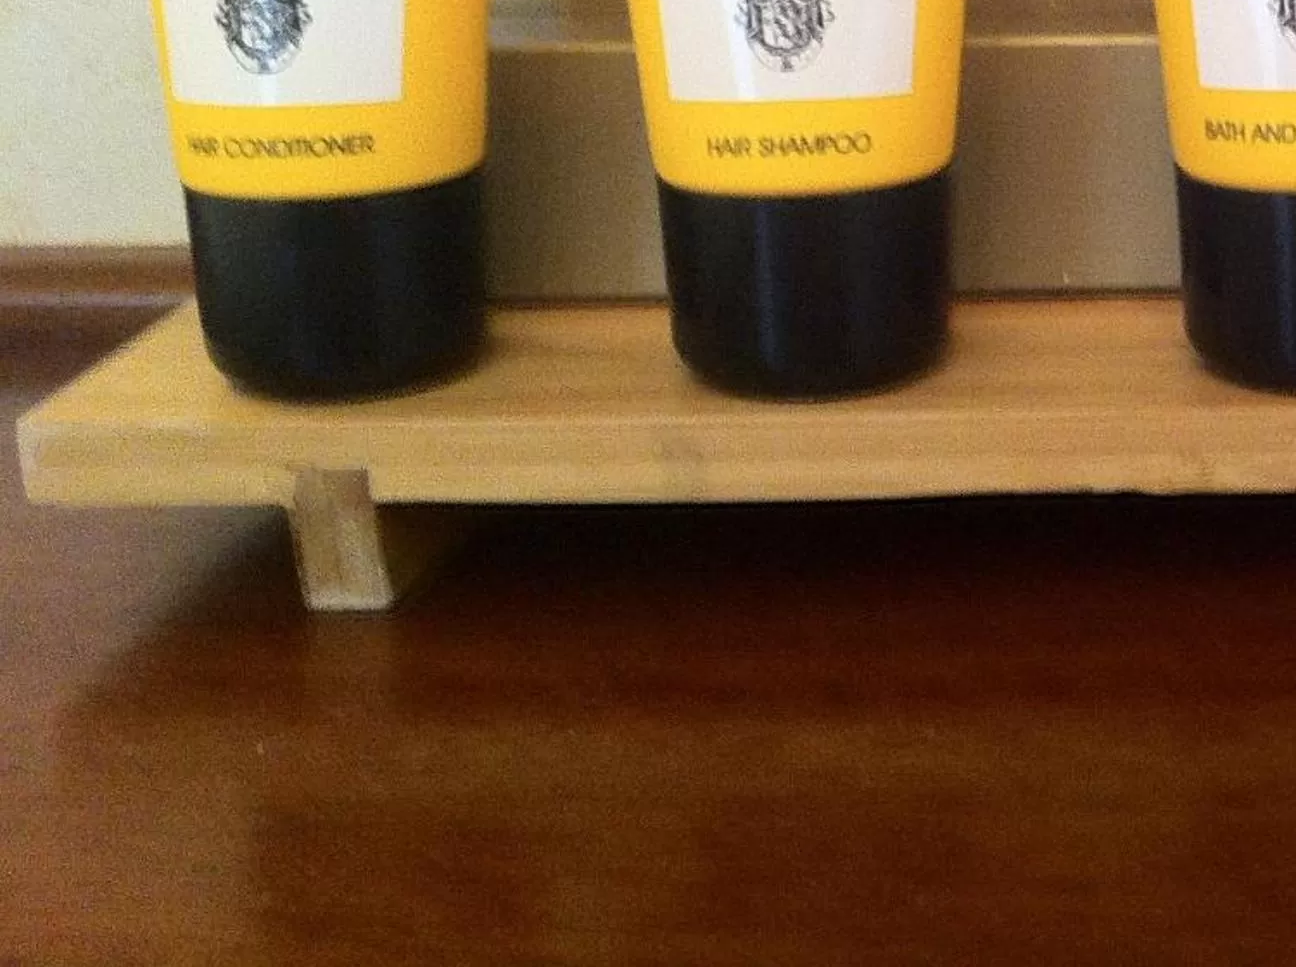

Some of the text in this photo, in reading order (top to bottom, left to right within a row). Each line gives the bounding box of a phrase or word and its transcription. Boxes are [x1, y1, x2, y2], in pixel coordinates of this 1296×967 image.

[1204, 119, 1246, 143] BATH
[223, 133, 377, 159] CONDITIONER
[706, 131, 872, 159] HAIR SHAMPOO
